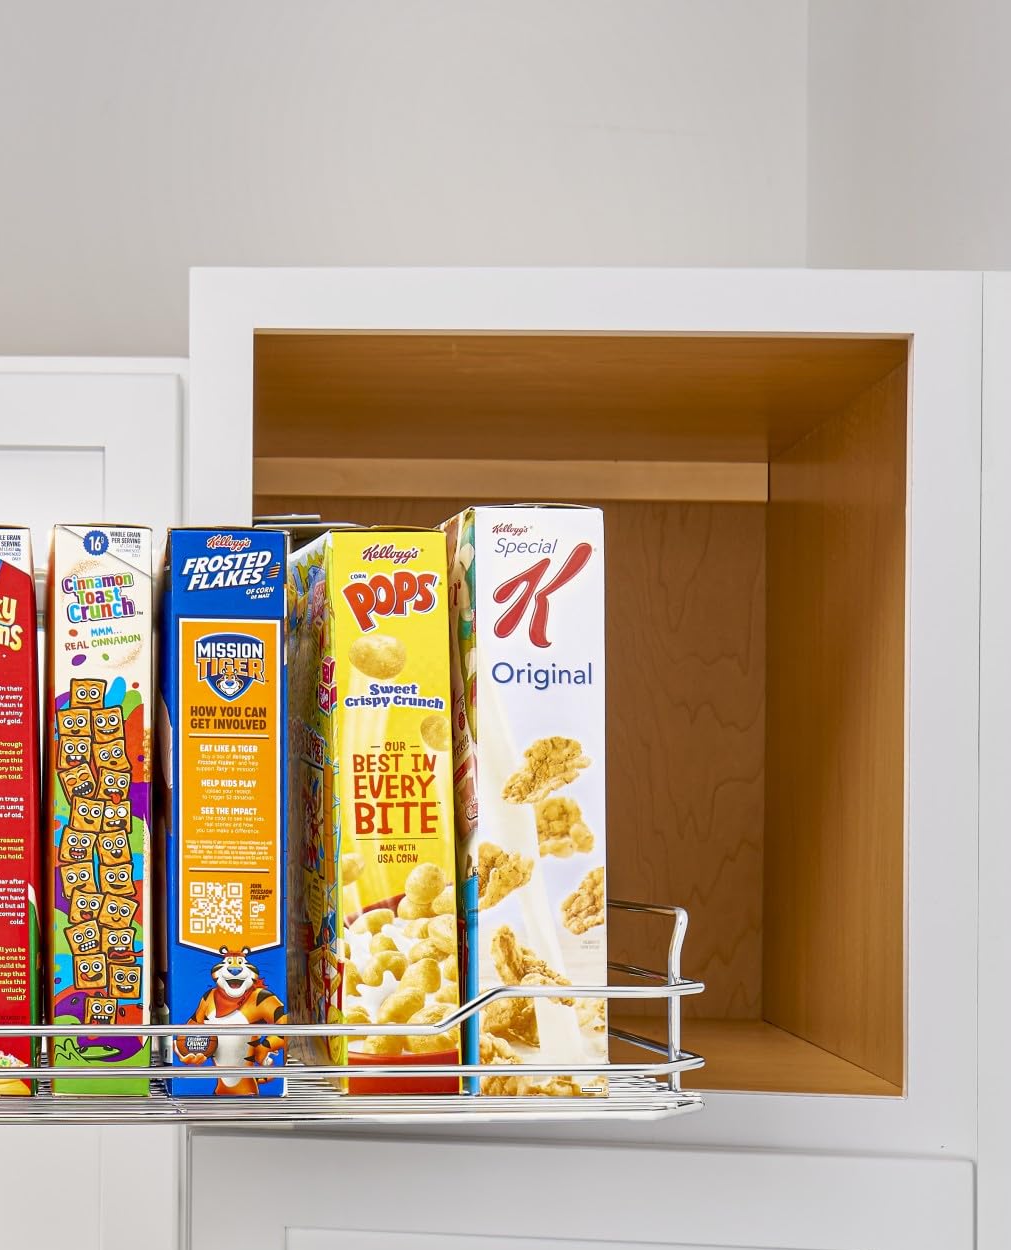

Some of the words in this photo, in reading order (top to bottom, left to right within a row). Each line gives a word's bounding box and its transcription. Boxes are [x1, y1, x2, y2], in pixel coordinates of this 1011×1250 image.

[492, 523, 529, 537] Kellogg's
[207, 535, 251, 551] Kellogg's
[494, 538, 559, 558] Special
[362, 544, 419, 564] Kellogg's
[182, 551, 272, 575] FROSTED
[63, 573, 133, 593] Cinnamon
[187, 568, 264, 591] FLAKES
[76, 586, 121, 605] Toast
[255, 586, 275, 594] CORN
[492, 542, 593, 649] K
[68, 597, 135, 622] Crunch
[343, 571, 438, 632] POPS
[64, 641, 90, 651] REAL
[91, 634, 141, 648] CINNAMON
[197, 642, 263, 659] MISSION
[198, 658, 265, 684] TIGER
[491, 662, 592, 691] Original
[369, 684, 419, 696] Sweet
[392, 695, 444, 710] Crunch
[190, 705, 217, 717] HOW
[219, 706, 242, 718] YOU
[244, 707, 267, 718] CAN
[190, 718, 211, 729] GET
[213, 719, 267, 730] INVOLVED
[199, 744, 213, 752] EAT
[214, 744, 230, 752] LIKE
[384, 742, 406, 752] OUR
[352, 754, 404, 773] BEST
[411, 754, 437, 773] IN
[201, 779, 220, 787] HELP
[220, 779, 238, 787] KIDS
[354, 774, 436, 800] EVERY
[200, 807, 215, 815] SEE
[215, 807, 230, 815] THE
[231, 807, 258, 815] IMPACT
[354, 801, 439, 835] BITE
[379, 844, 397, 852] MADE
[398, 844, 416, 852] WITH
[377, 854, 394, 863] USA
[396, 854, 419, 863] CORN
